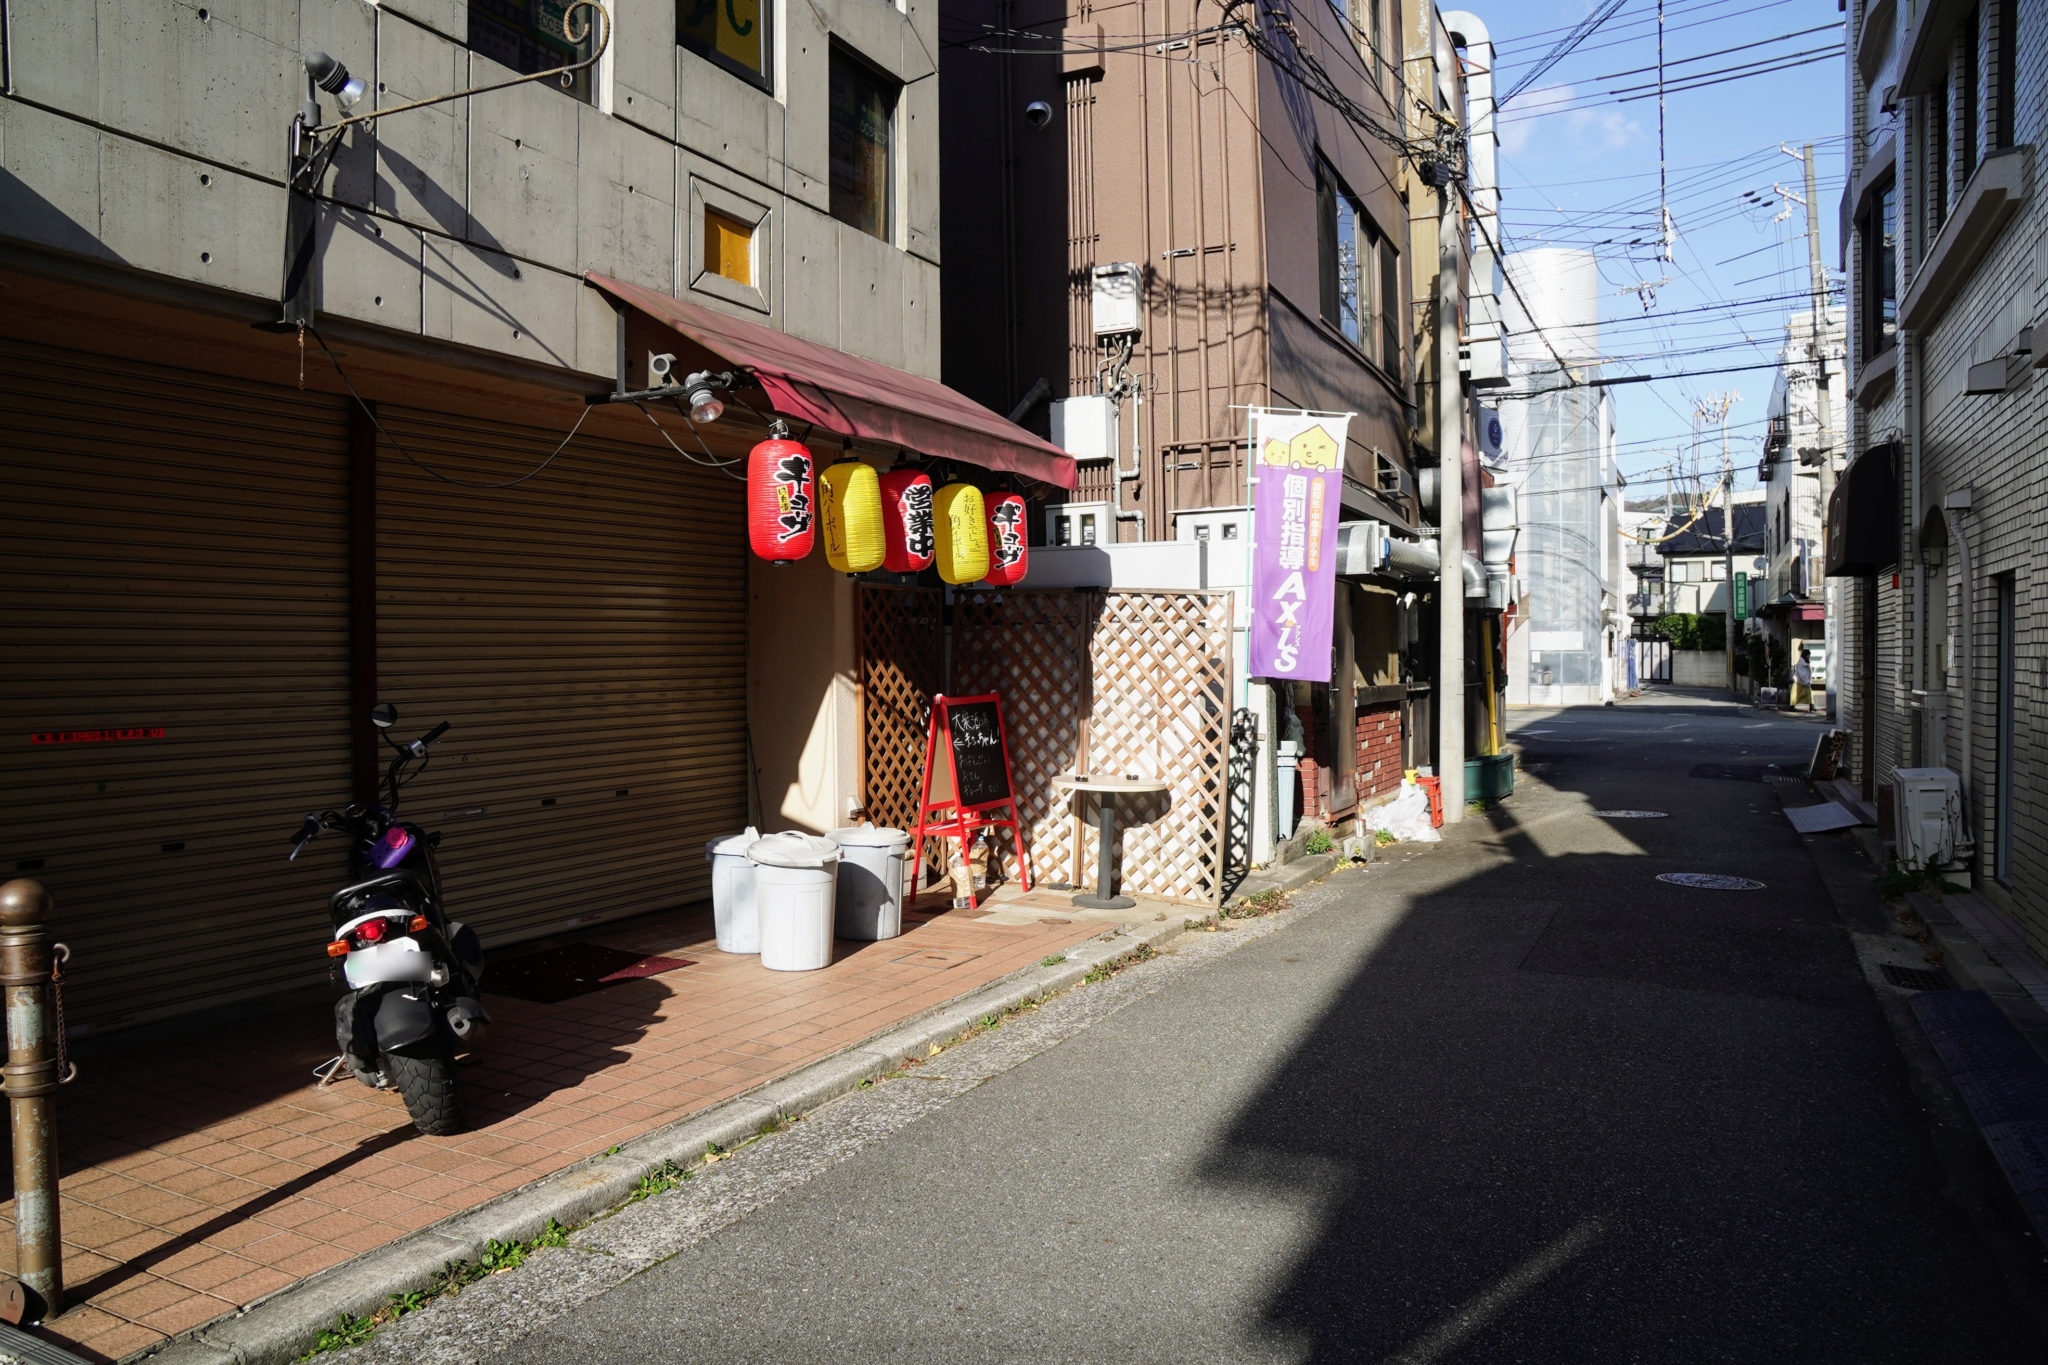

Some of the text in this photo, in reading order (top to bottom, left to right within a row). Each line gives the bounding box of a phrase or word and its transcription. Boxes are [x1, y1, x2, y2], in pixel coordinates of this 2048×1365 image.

[775, 455, 812, 541] ギョーザ
[821, 480, 841, 553] 角ハイボール
[904, 484, 935, 558] 営業中
[1278, 473, 1308, 570] 個別指導
[991, 502, 1023, 570] ギョーザ
[951, 709, 990, 735] 大衆酒場
[962, 770, 981, 782] おでん
